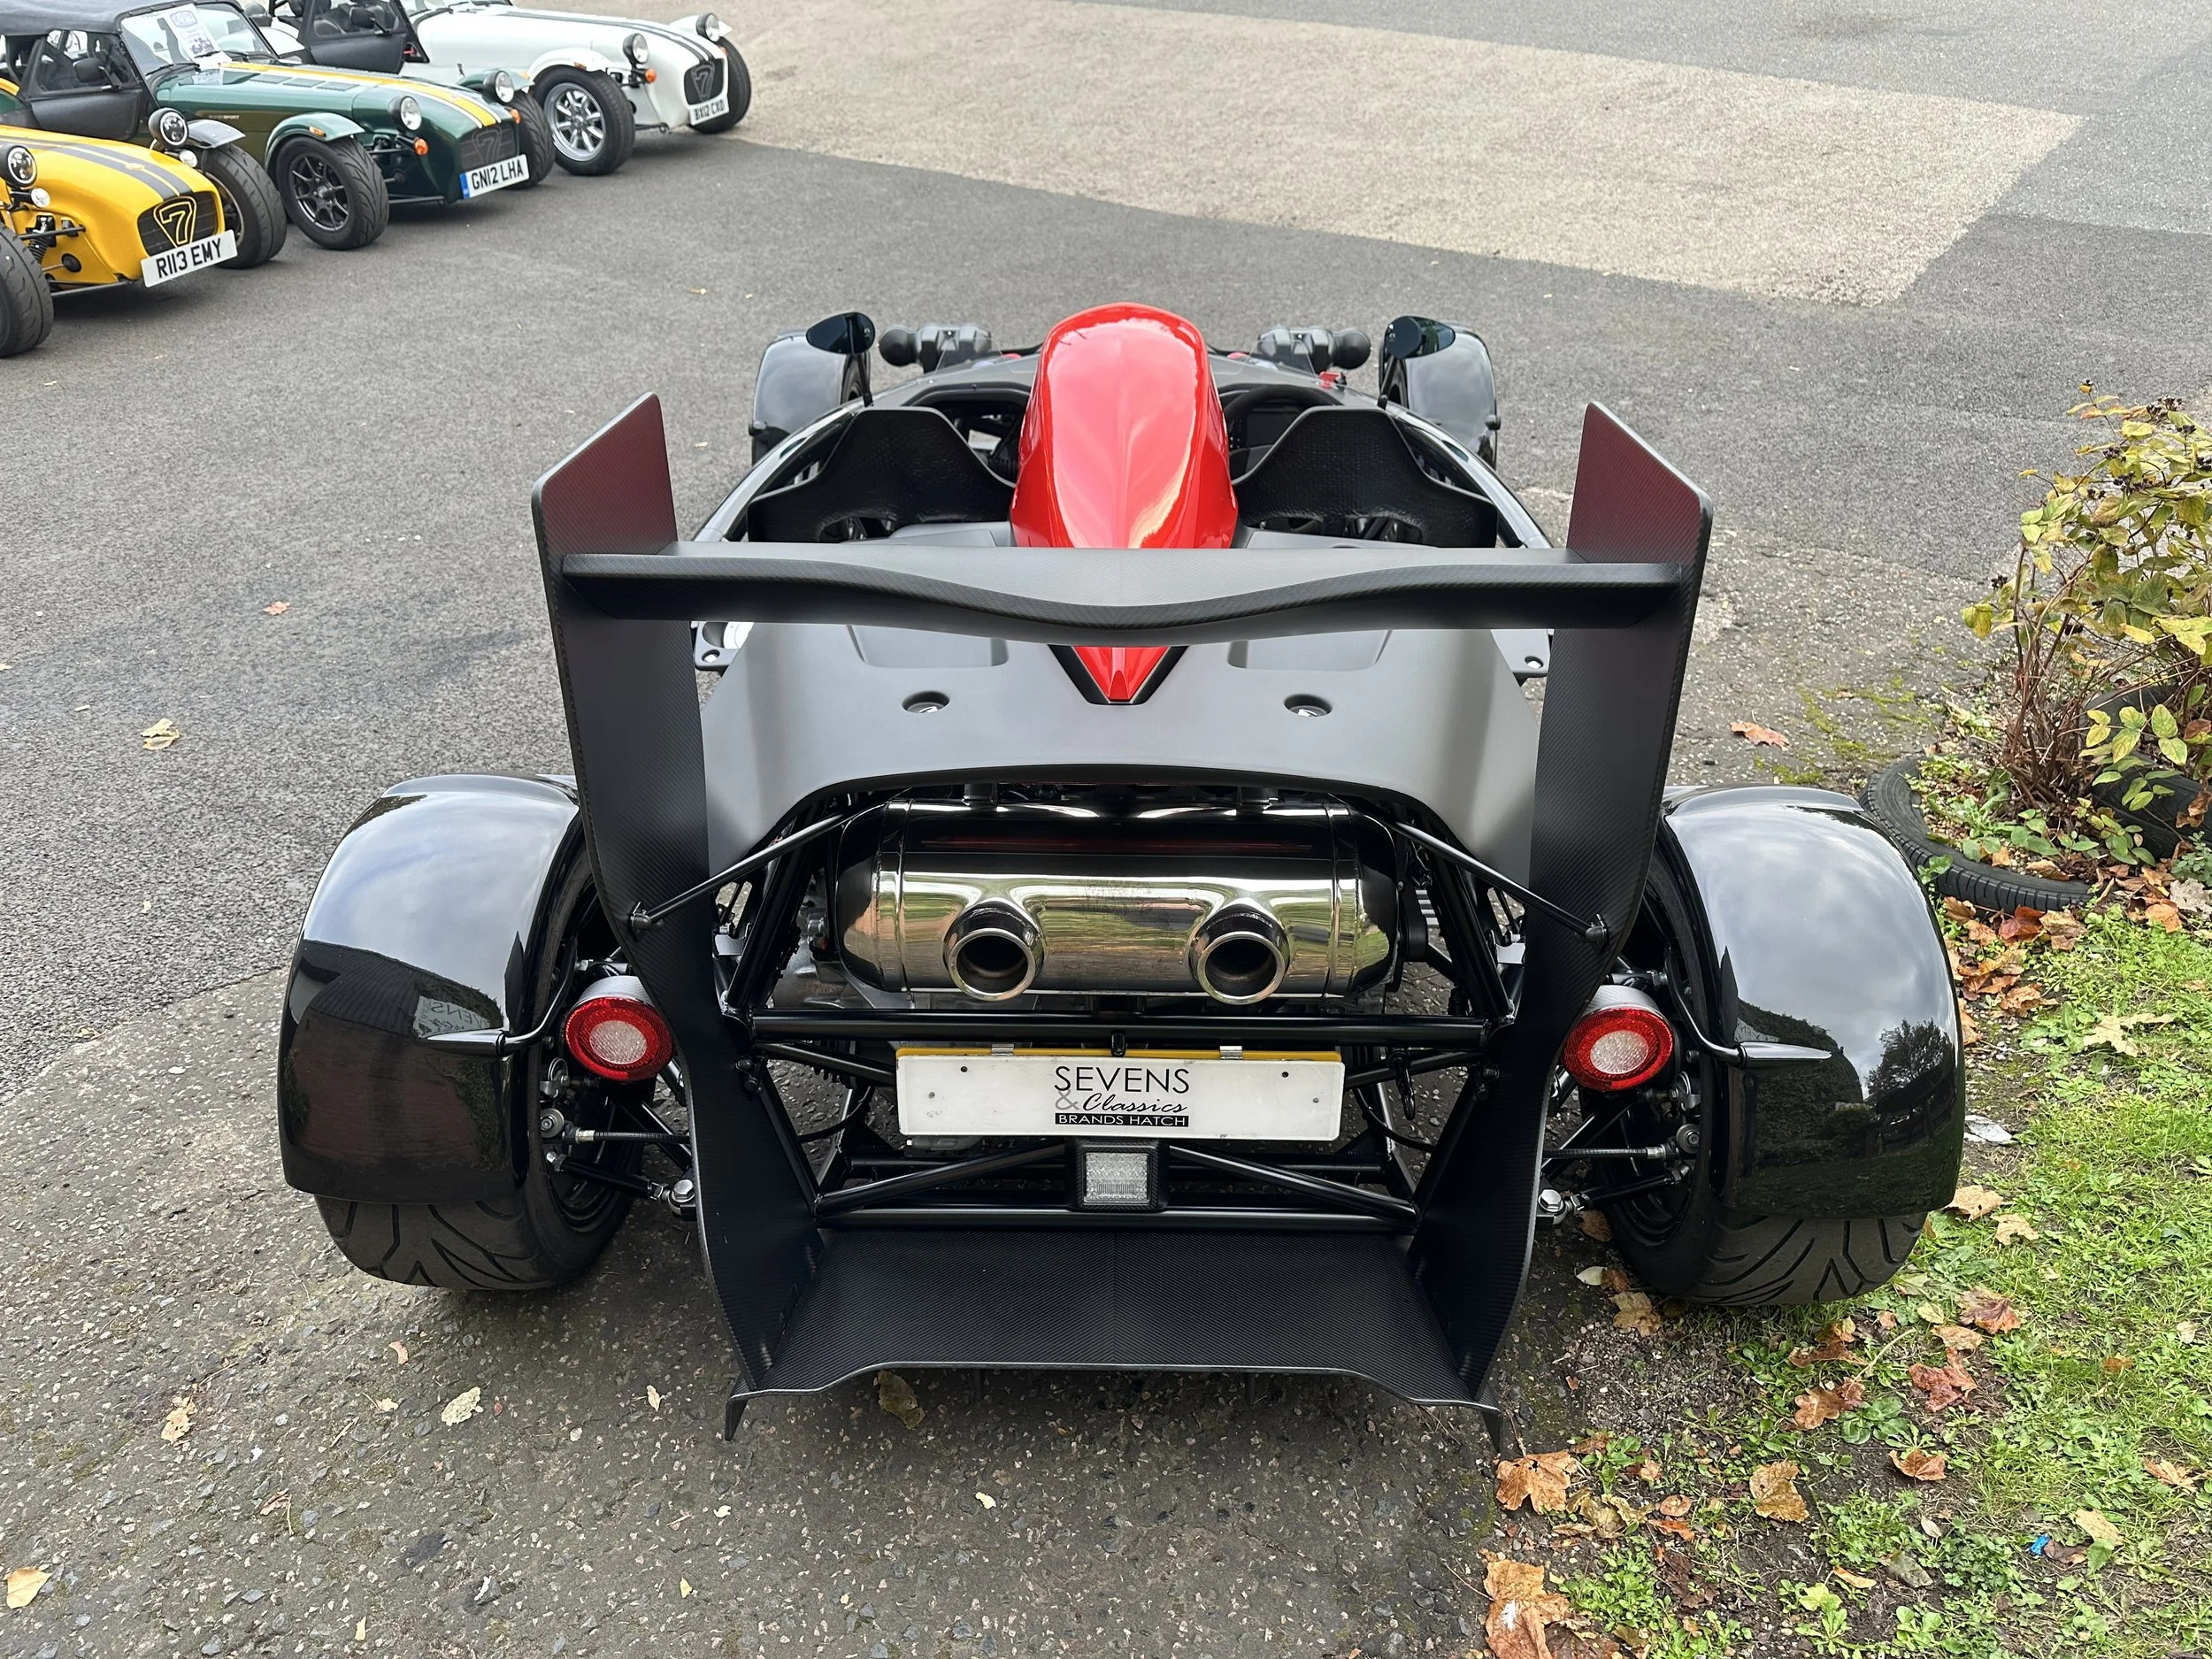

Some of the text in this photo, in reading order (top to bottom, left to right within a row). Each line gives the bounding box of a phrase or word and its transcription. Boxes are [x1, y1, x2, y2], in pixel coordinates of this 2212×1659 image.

[471, 158, 524, 190] GN12 LHA
[158, 201, 193, 246] 7
[156, 237, 221, 279] R113 EMY
[1054, 1065, 1190, 1094] SEVENS
[1055, 1088, 1188, 1113] & Classics
[1058, 1114, 1186, 1126] BRANDS HATCH
